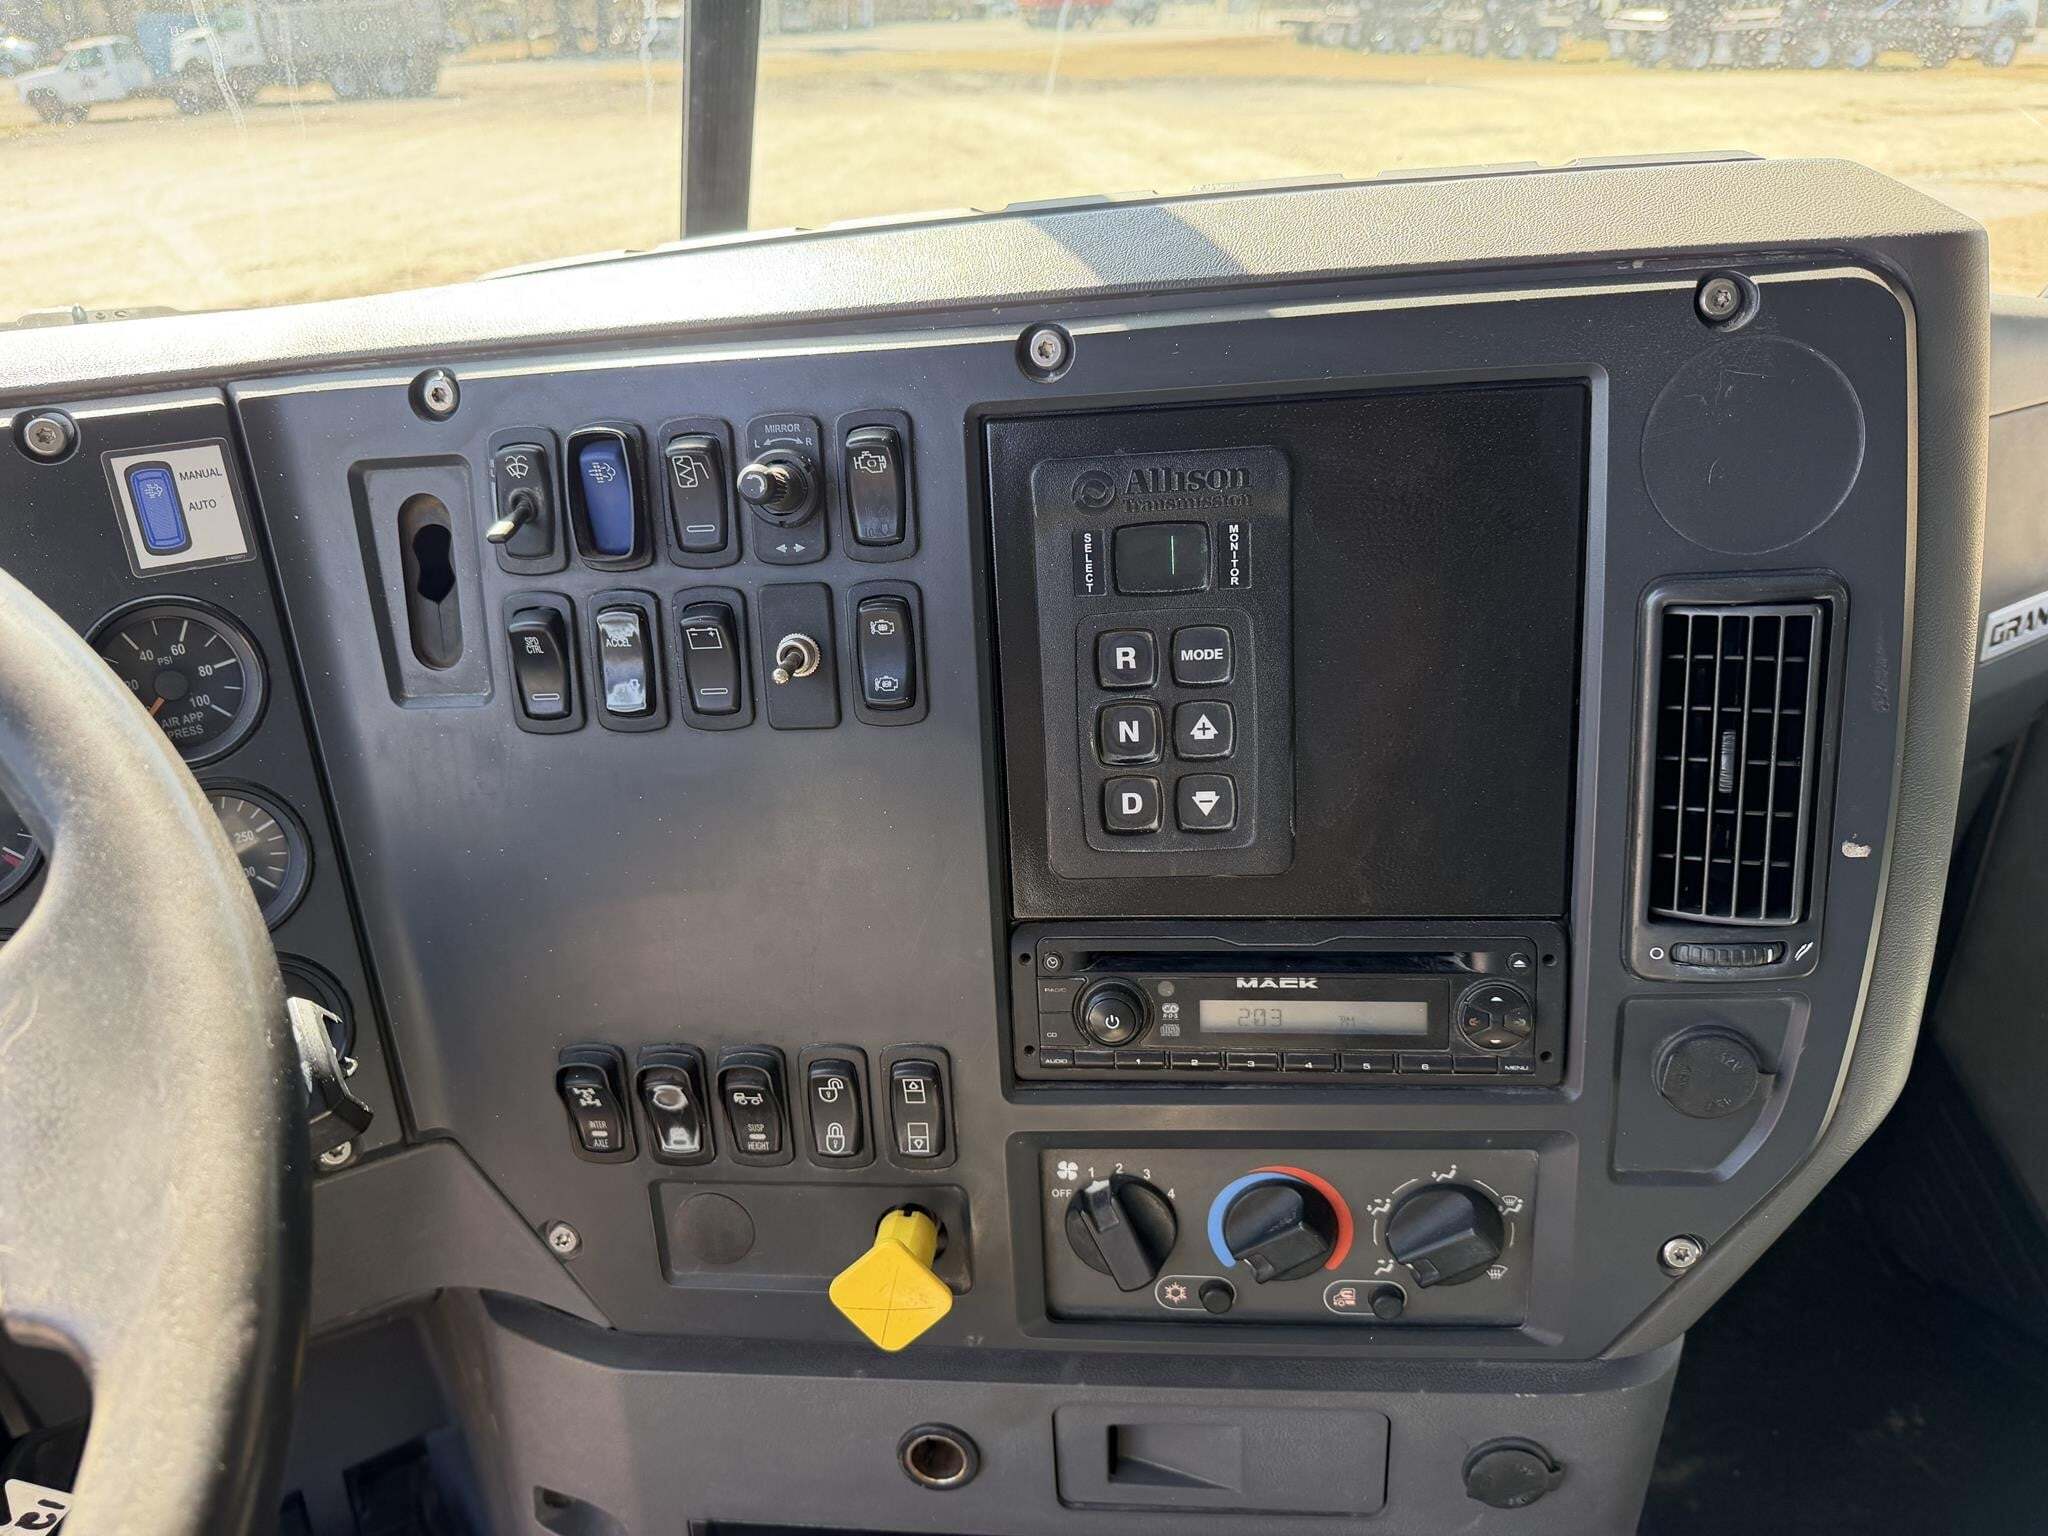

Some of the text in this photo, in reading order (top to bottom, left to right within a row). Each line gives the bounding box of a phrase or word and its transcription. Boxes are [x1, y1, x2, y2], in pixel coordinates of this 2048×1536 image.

[764, 423, 801, 433] MIRROR
[754, 439, 760, 448] L
[805, 437, 813, 446] R
[179, 467, 223, 481] MANUAL
[1124, 465, 1251, 495] Allison
[188, 498, 217, 512] AUTO
[1124, 494, 1251, 513] Transmission
[1228, 524, 1240, 586] MONITOR
[1083, 533, 1094, 593] SELECT
[139, 649, 154, 661] 40
[170, 643, 186, 656] 60
[1181, 648, 1224, 661] MODE
[157, 655, 173, 666] PSI
[1116, 647, 1137, 669] R
[198, 665, 213, 677] 80
[190, 694, 210, 708] 100
[161, 711, 204, 729] AIR APP
[167, 724, 205, 739] PRESS
[1118, 720, 1140, 742] N
[1121, 792, 1143, 815] D
[234, 830, 254, 843] 250
[1236, 977, 1319, 989] MACK
[748, 1123, 765, 1133] SUSP
[747, 1141, 770, 1151] HEIGHT
[1088, 1167, 1095, 1178] 1
[1115, 1163, 1124, 1174] 2
[1143, 1168, 1151, 1180] 3
[1051, 1188, 1072, 1199] OFF
[1167, 1188, 1176, 1198] 4
